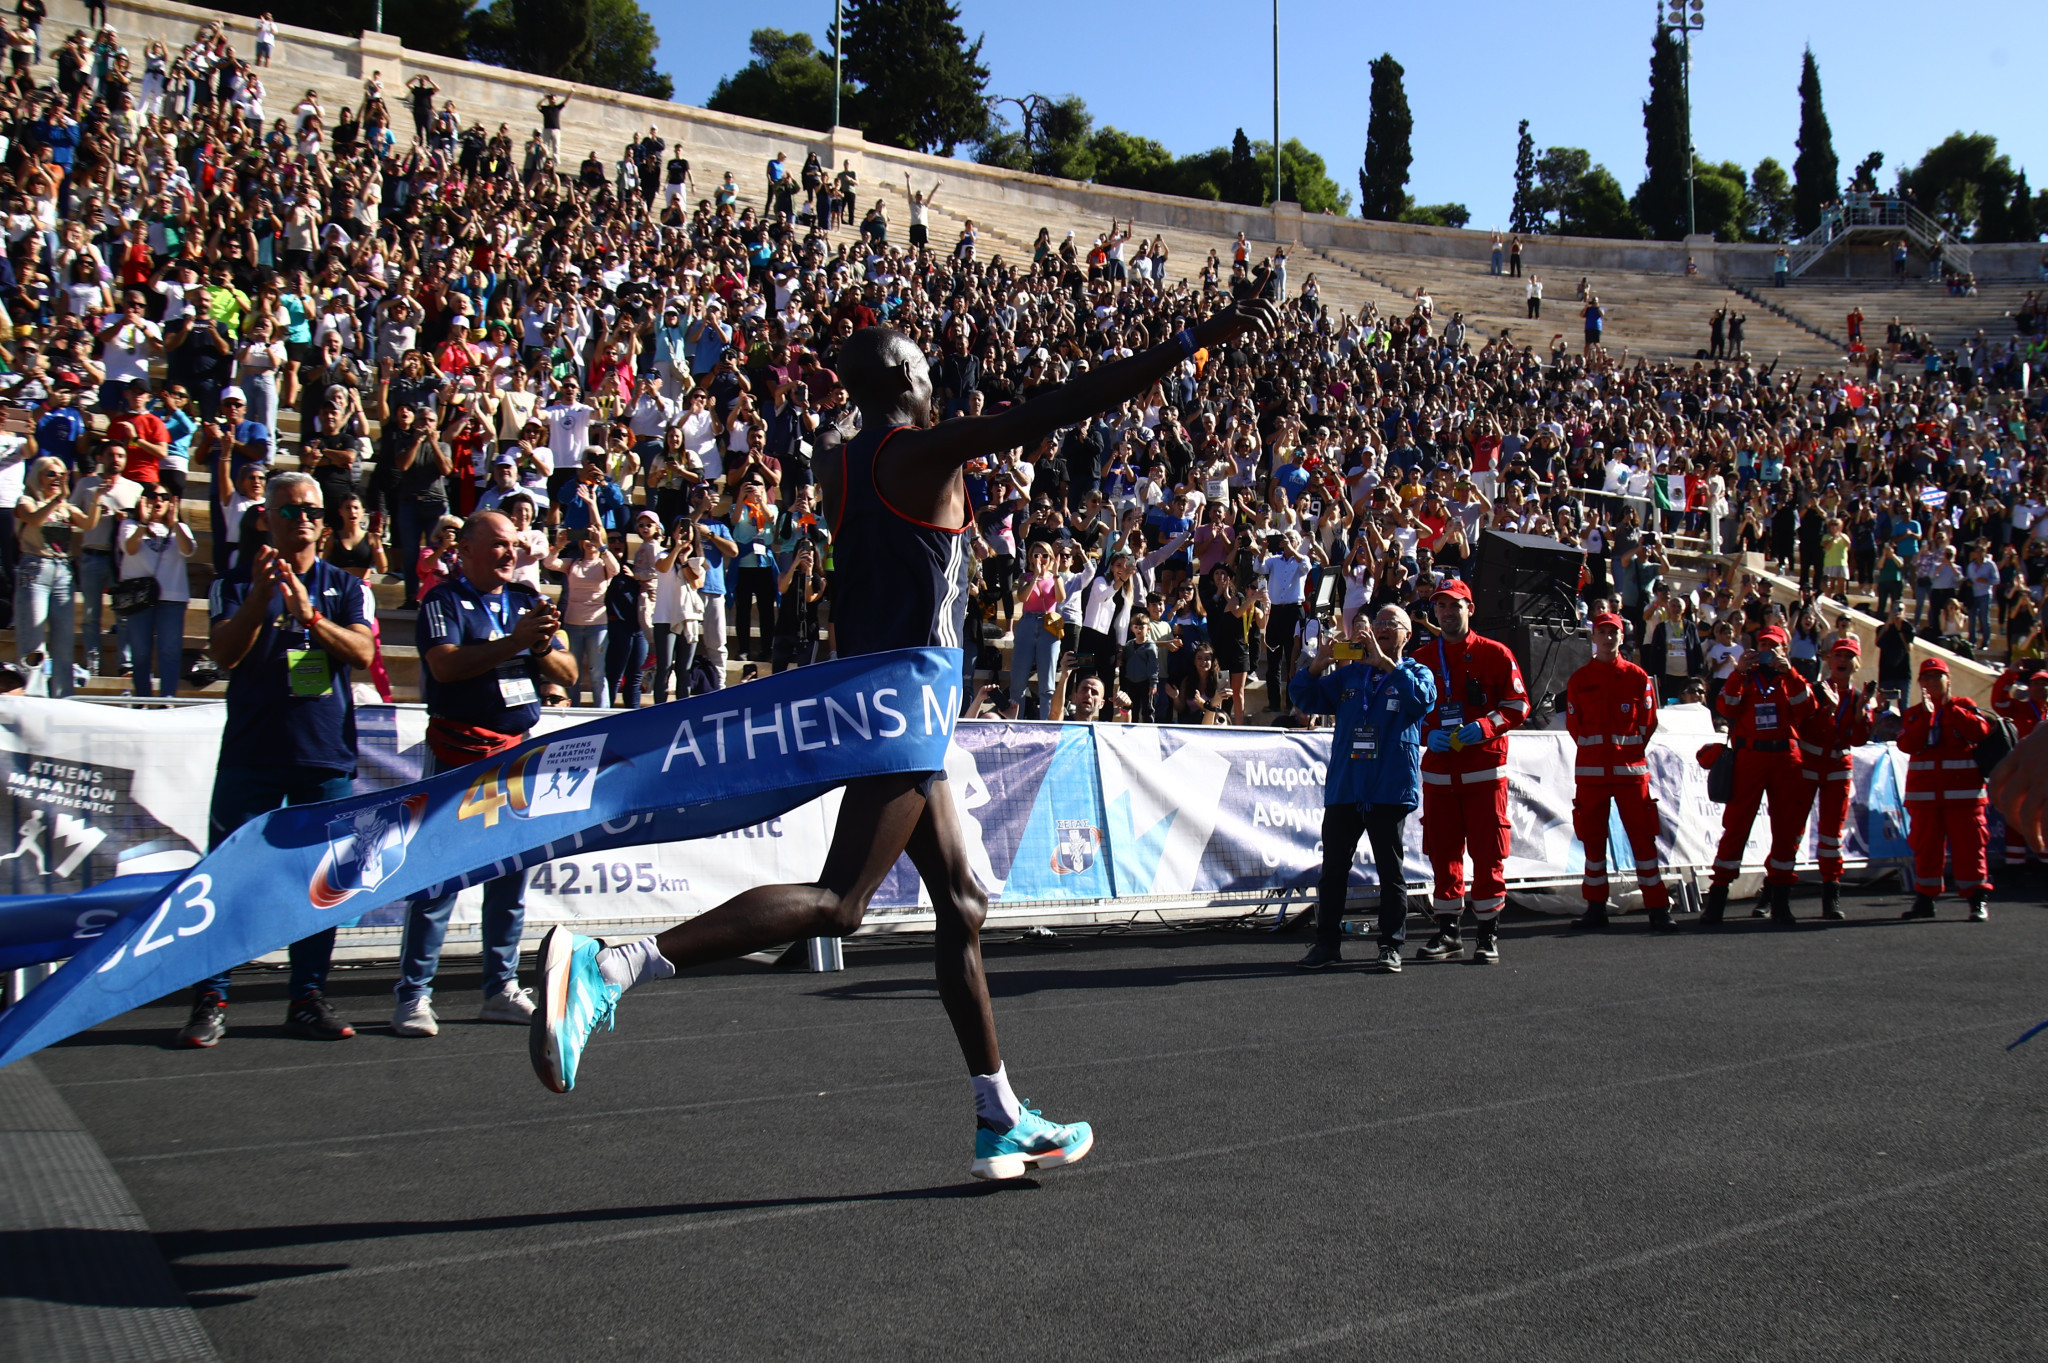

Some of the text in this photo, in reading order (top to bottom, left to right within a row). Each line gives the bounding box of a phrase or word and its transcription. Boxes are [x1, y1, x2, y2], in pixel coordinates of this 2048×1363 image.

[661, 688, 907, 773] ATHENS
[548, 748, 596, 758] MARATHON
[559, 741, 591, 750] ATHENS
[29, 761, 103, 783] ATHENS
[6, 786, 115, 814] THE AUTHENTIC
[8, 772, 117, 801] MARATHON
[97, 873, 216, 973] 23
